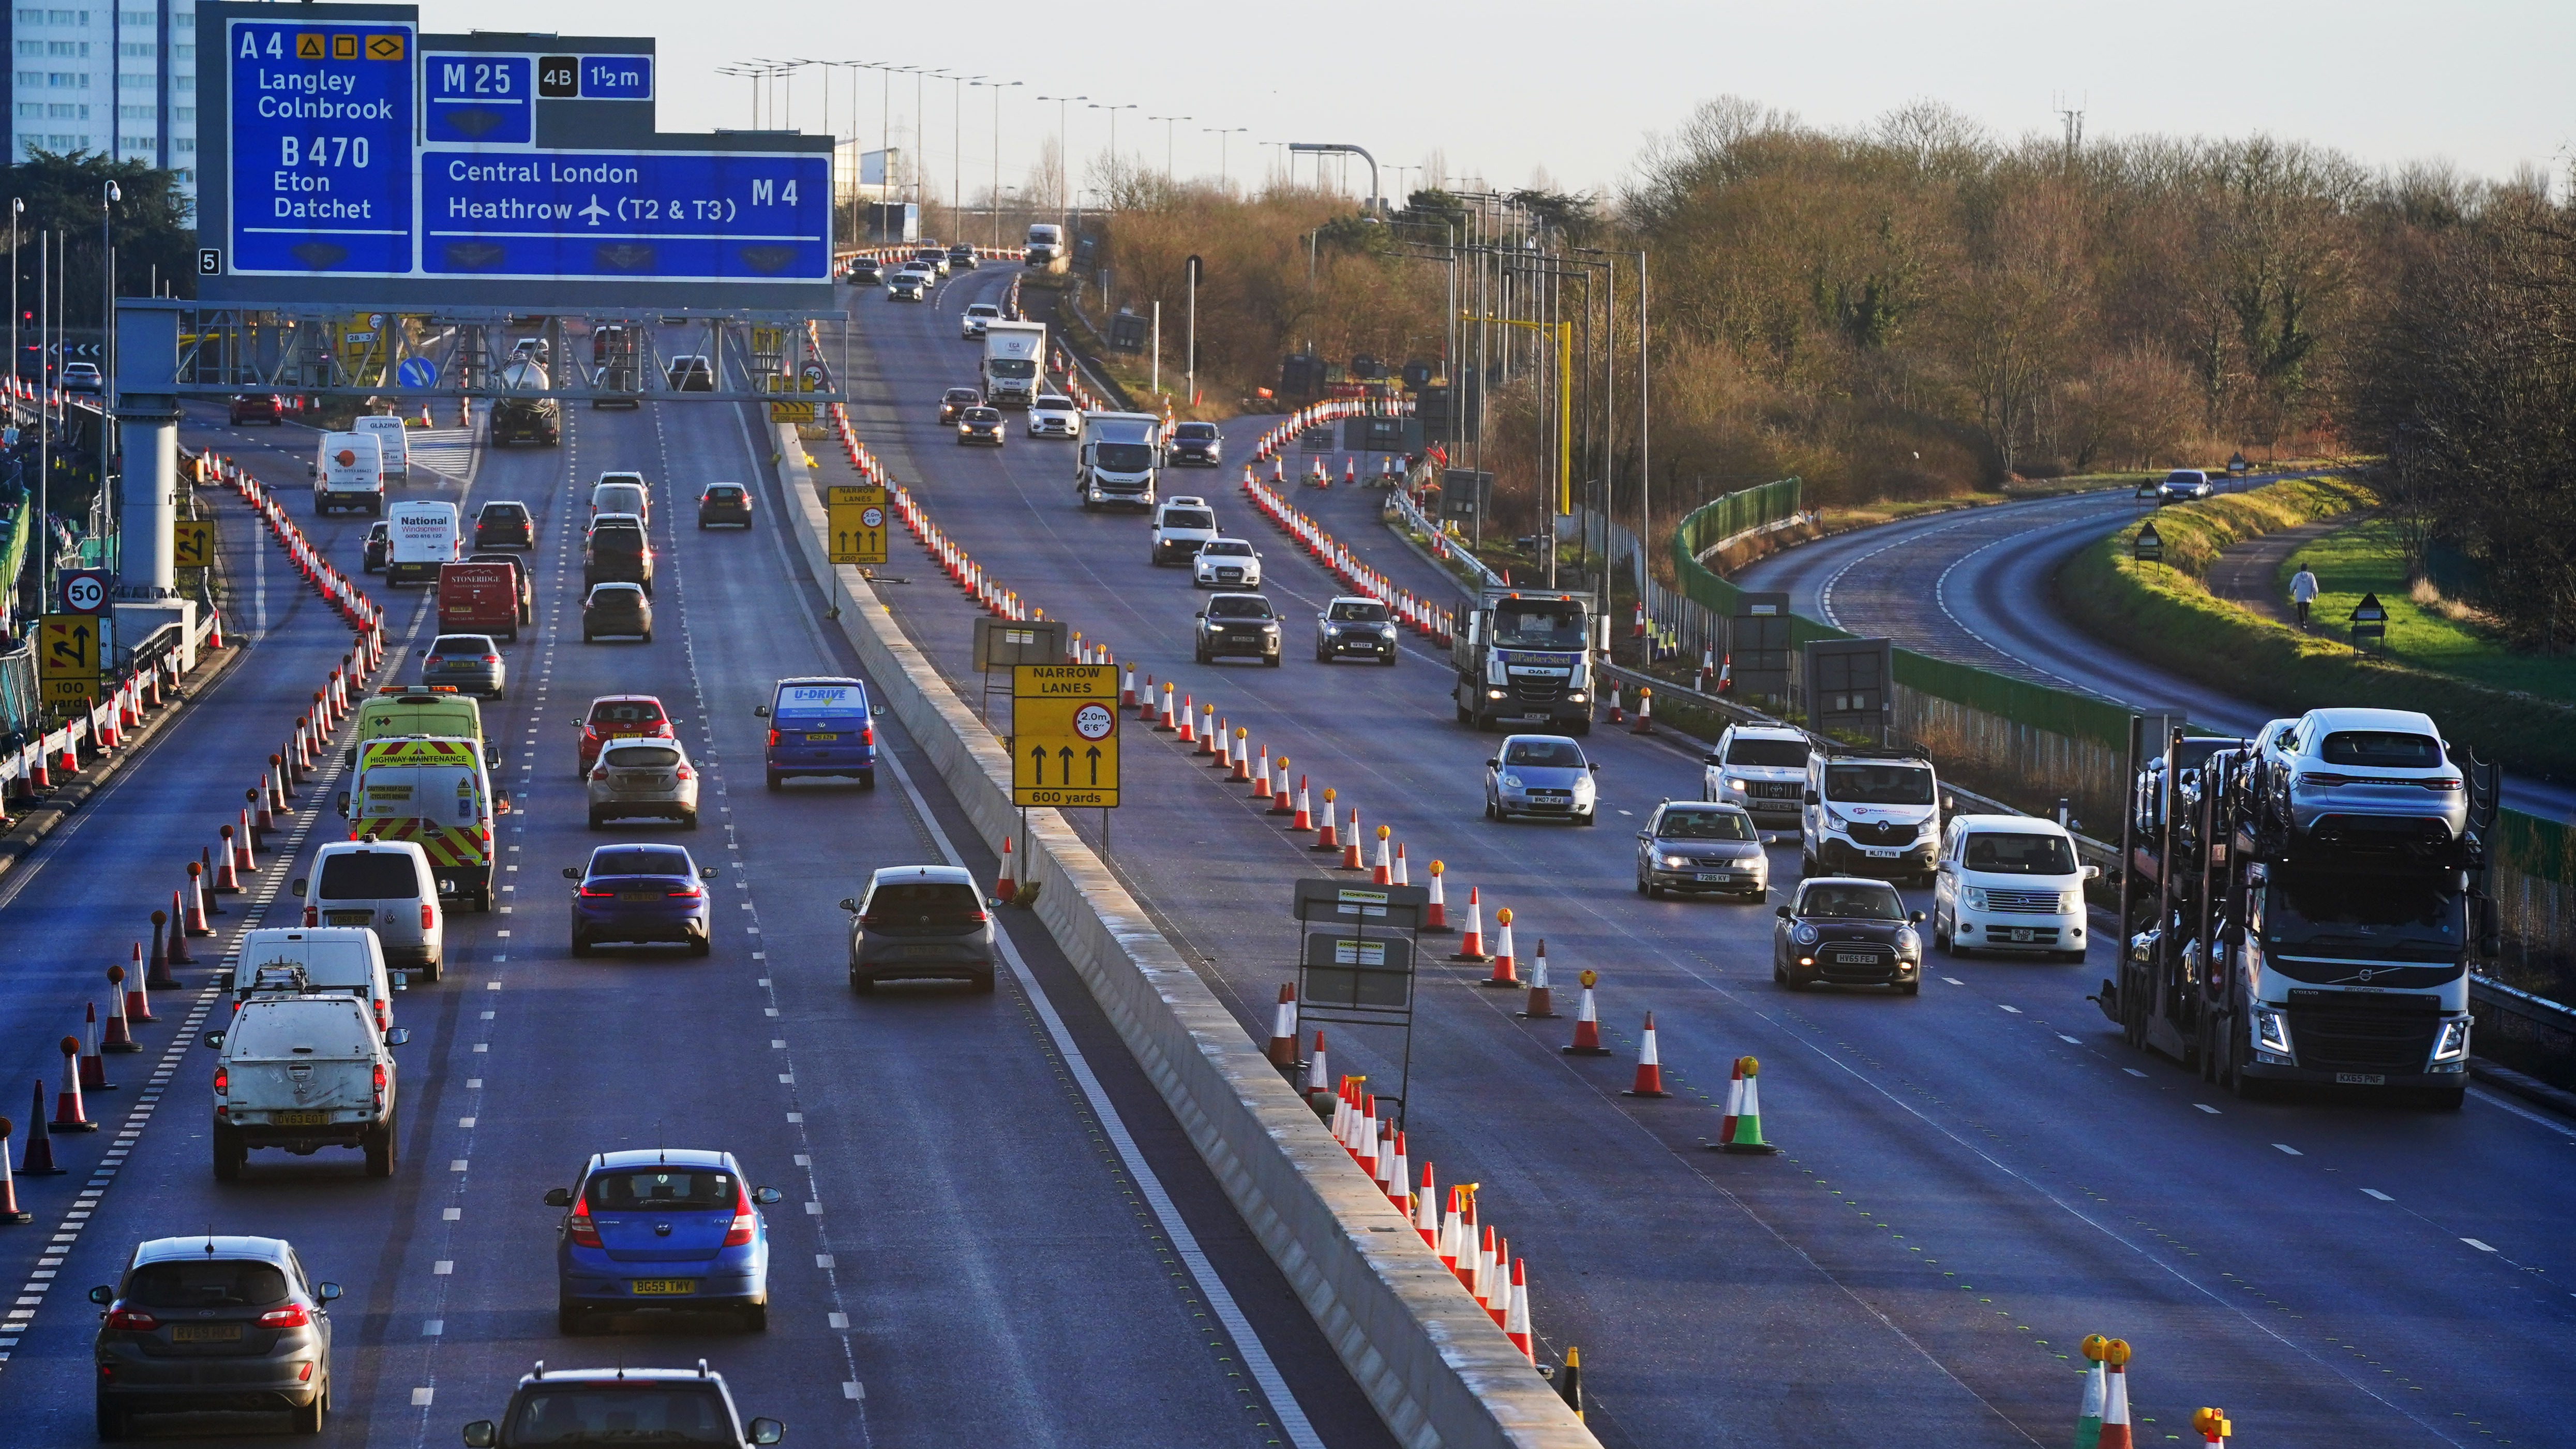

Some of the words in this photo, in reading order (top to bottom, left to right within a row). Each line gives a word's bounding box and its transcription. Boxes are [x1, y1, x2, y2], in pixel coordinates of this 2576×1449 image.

[260, 68, 356, 95] Langley
[544, 69, 572, 86] 4B
[259, 96, 393, 119] Colnbrook
[449, 160, 540, 182] Central
[551, 162, 638, 183] London
[275, 171, 330, 191] Eton
[275, 197, 371, 219] Datchet
[449, 197, 572, 219] Heathrow
[617, 196, 659, 222] (T2
[668, 201, 684, 219] &
[693, 200, 736, 222] T3)
[203, 254, 215, 270] 5
[401, 516, 447, 525] National
[71, 584, 101, 602] 50
[1034, 667, 1100, 678] NARROW
[55, 682, 84, 693] 100
[795, 689, 847, 699] U-DRIVE
[1041, 683, 1092, 693] LANES
[50, 698, 90, 710] yards
[1081, 712, 1107, 721] 2.0m
[1032, 791, 1061, 802] 600
[1065, 792, 1101, 804] yards
[2340, 1073, 2362, 1082] KX65
[2364, 1074, 2382, 1083] PNF
[637, 1281, 666, 1292] BG59
[669, 1281, 691, 1291] TMY
